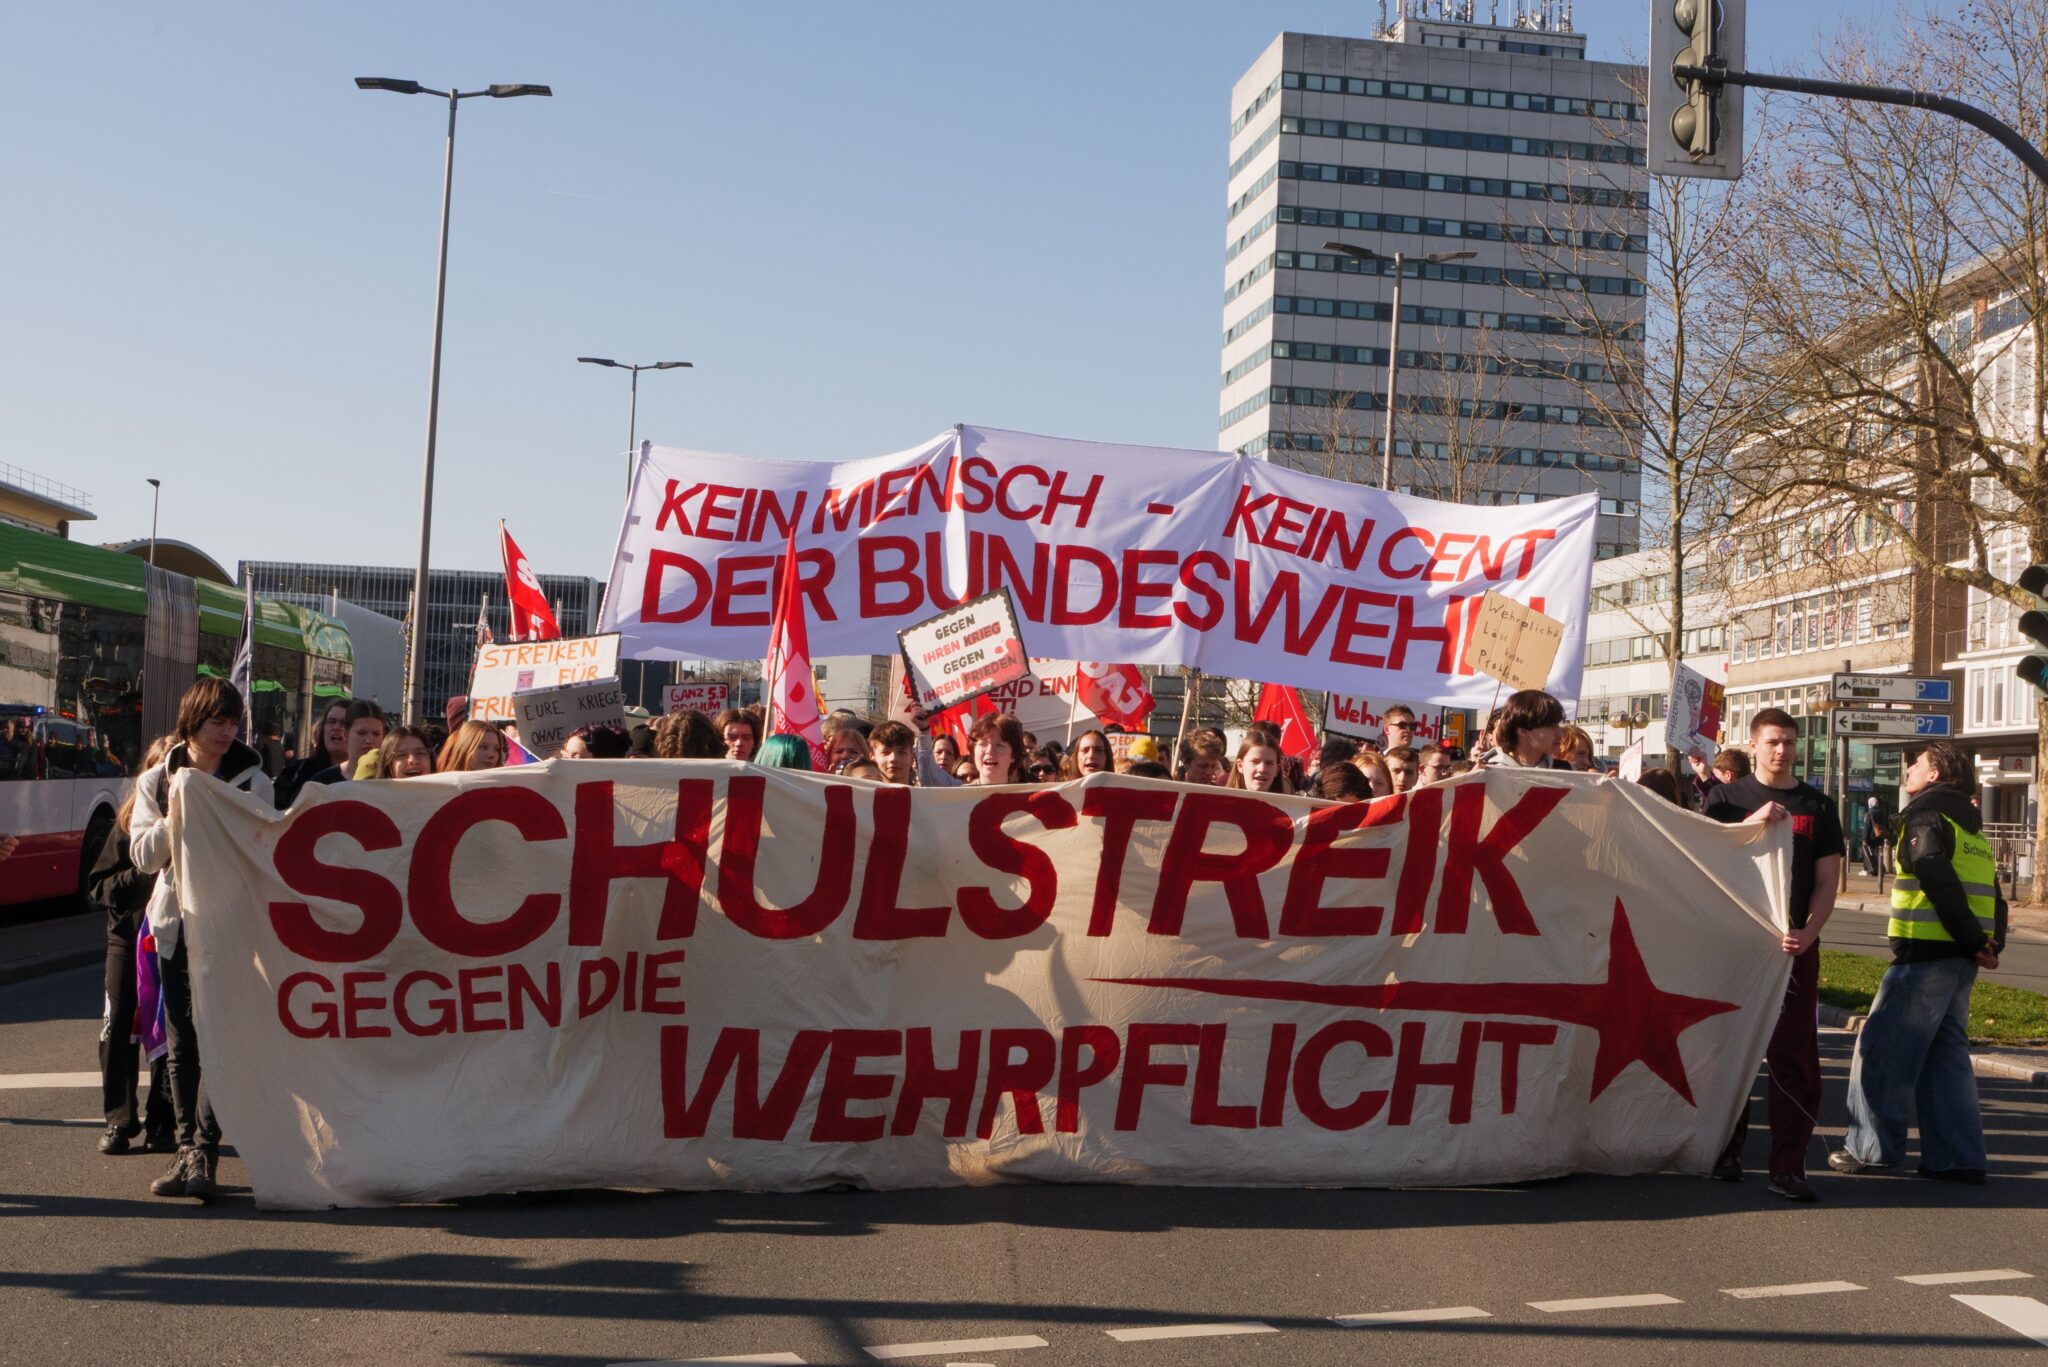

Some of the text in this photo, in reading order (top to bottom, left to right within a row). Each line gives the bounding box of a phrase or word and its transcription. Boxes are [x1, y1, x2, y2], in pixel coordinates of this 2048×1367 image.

[655, 478, 807, 542] KEIN
[812, 455, 1104, 535] MENSCH
[1222, 484, 1376, 572] KEIN
[1378, 527, 1556, 582] CENT
[640, 531, 1545, 676] DER BUNDESWEH
[935, 614, 975, 640] GEGEN
[483, 639, 598, 669] STREIKEN
[923, 621, 1001, 665] IHREN KRIEG
[559, 664, 599, 685] FÜR
[943, 649, 985, 675] GEGEN
[923, 678, 961, 704] IHREN
[964, 654, 1018, 685] FRIEDEN
[1916, 682, 1926, 698] P
[524, 690, 619, 721] EURE KRIEGE
[671, 688, 704, 702] GANZ
[531, 727, 565, 746] OHNE
[268, 776, 1571, 963] SCHULSTREIK
[277, 950, 686, 1039] GEGEN DIE
[660, 1020, 1558, 1143] WEHRPFLICHT
